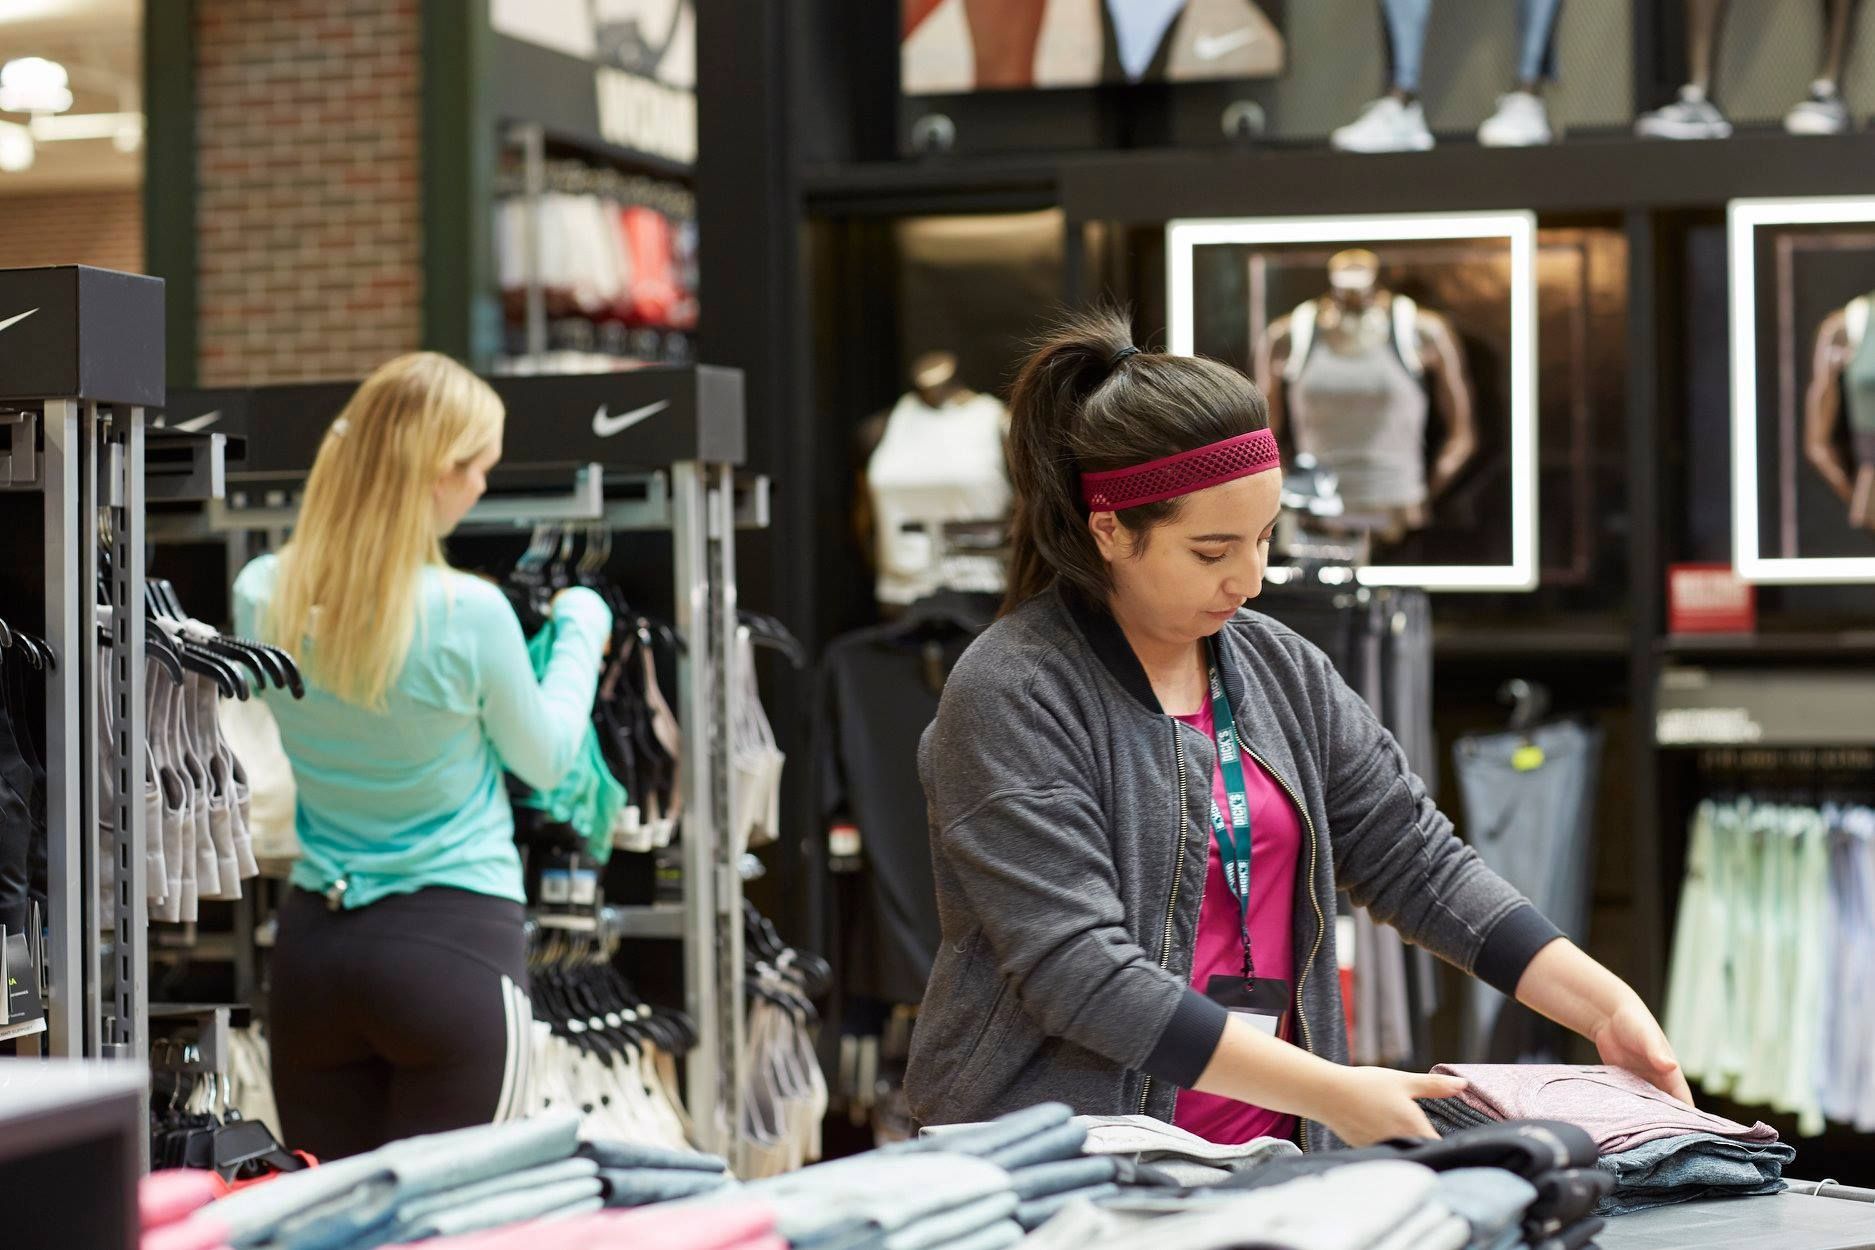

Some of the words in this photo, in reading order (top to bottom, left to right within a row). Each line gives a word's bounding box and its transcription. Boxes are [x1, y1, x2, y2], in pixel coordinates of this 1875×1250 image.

[1209, 667, 1222, 699] DICK'S
[1218, 730, 1234, 762] DICK'S
[1229, 793, 1246, 826] DICK'S
[1238, 861, 1249, 894] DICK'S
